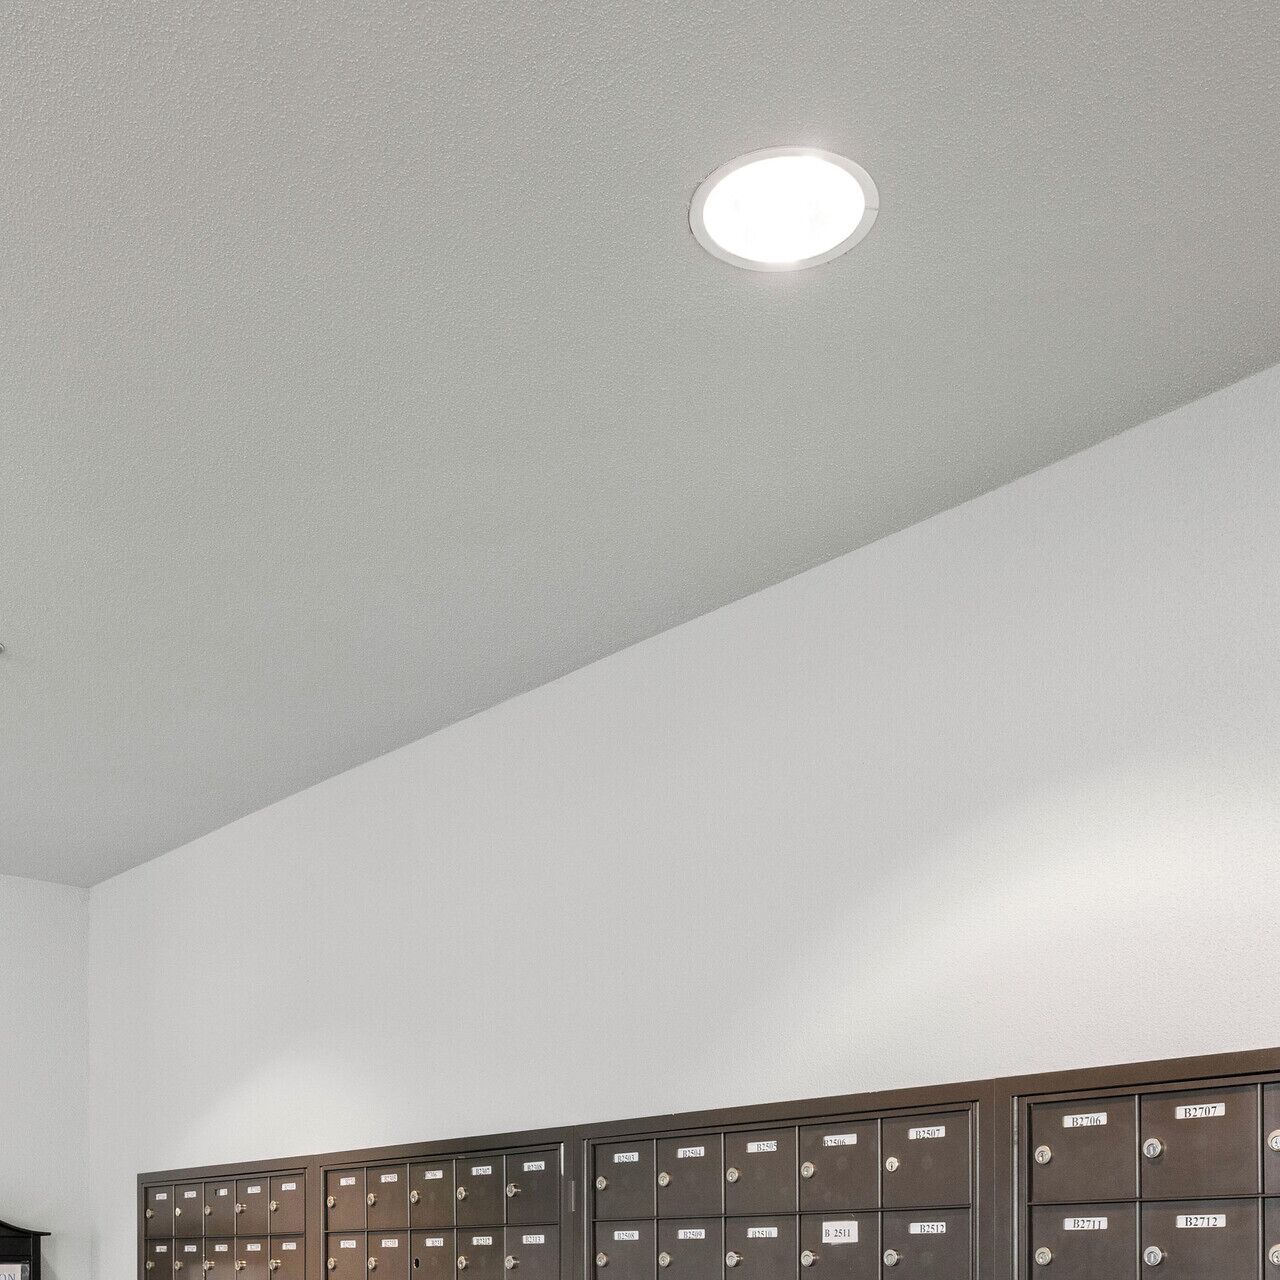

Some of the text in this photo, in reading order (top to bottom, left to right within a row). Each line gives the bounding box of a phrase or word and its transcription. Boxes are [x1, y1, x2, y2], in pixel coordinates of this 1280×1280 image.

[1184, 1106, 1218, 1118] B2707
[1071, 1115, 1101, 1127] B2706
[915, 1129, 940, 1138] B2507
[1073, 1218, 1102, 1229] B2711
[1184, 1217, 1218, 1227] B2712
[824, 1229, 850, 1237] B 2511
[920, 1224, 944, 1233] B2512
